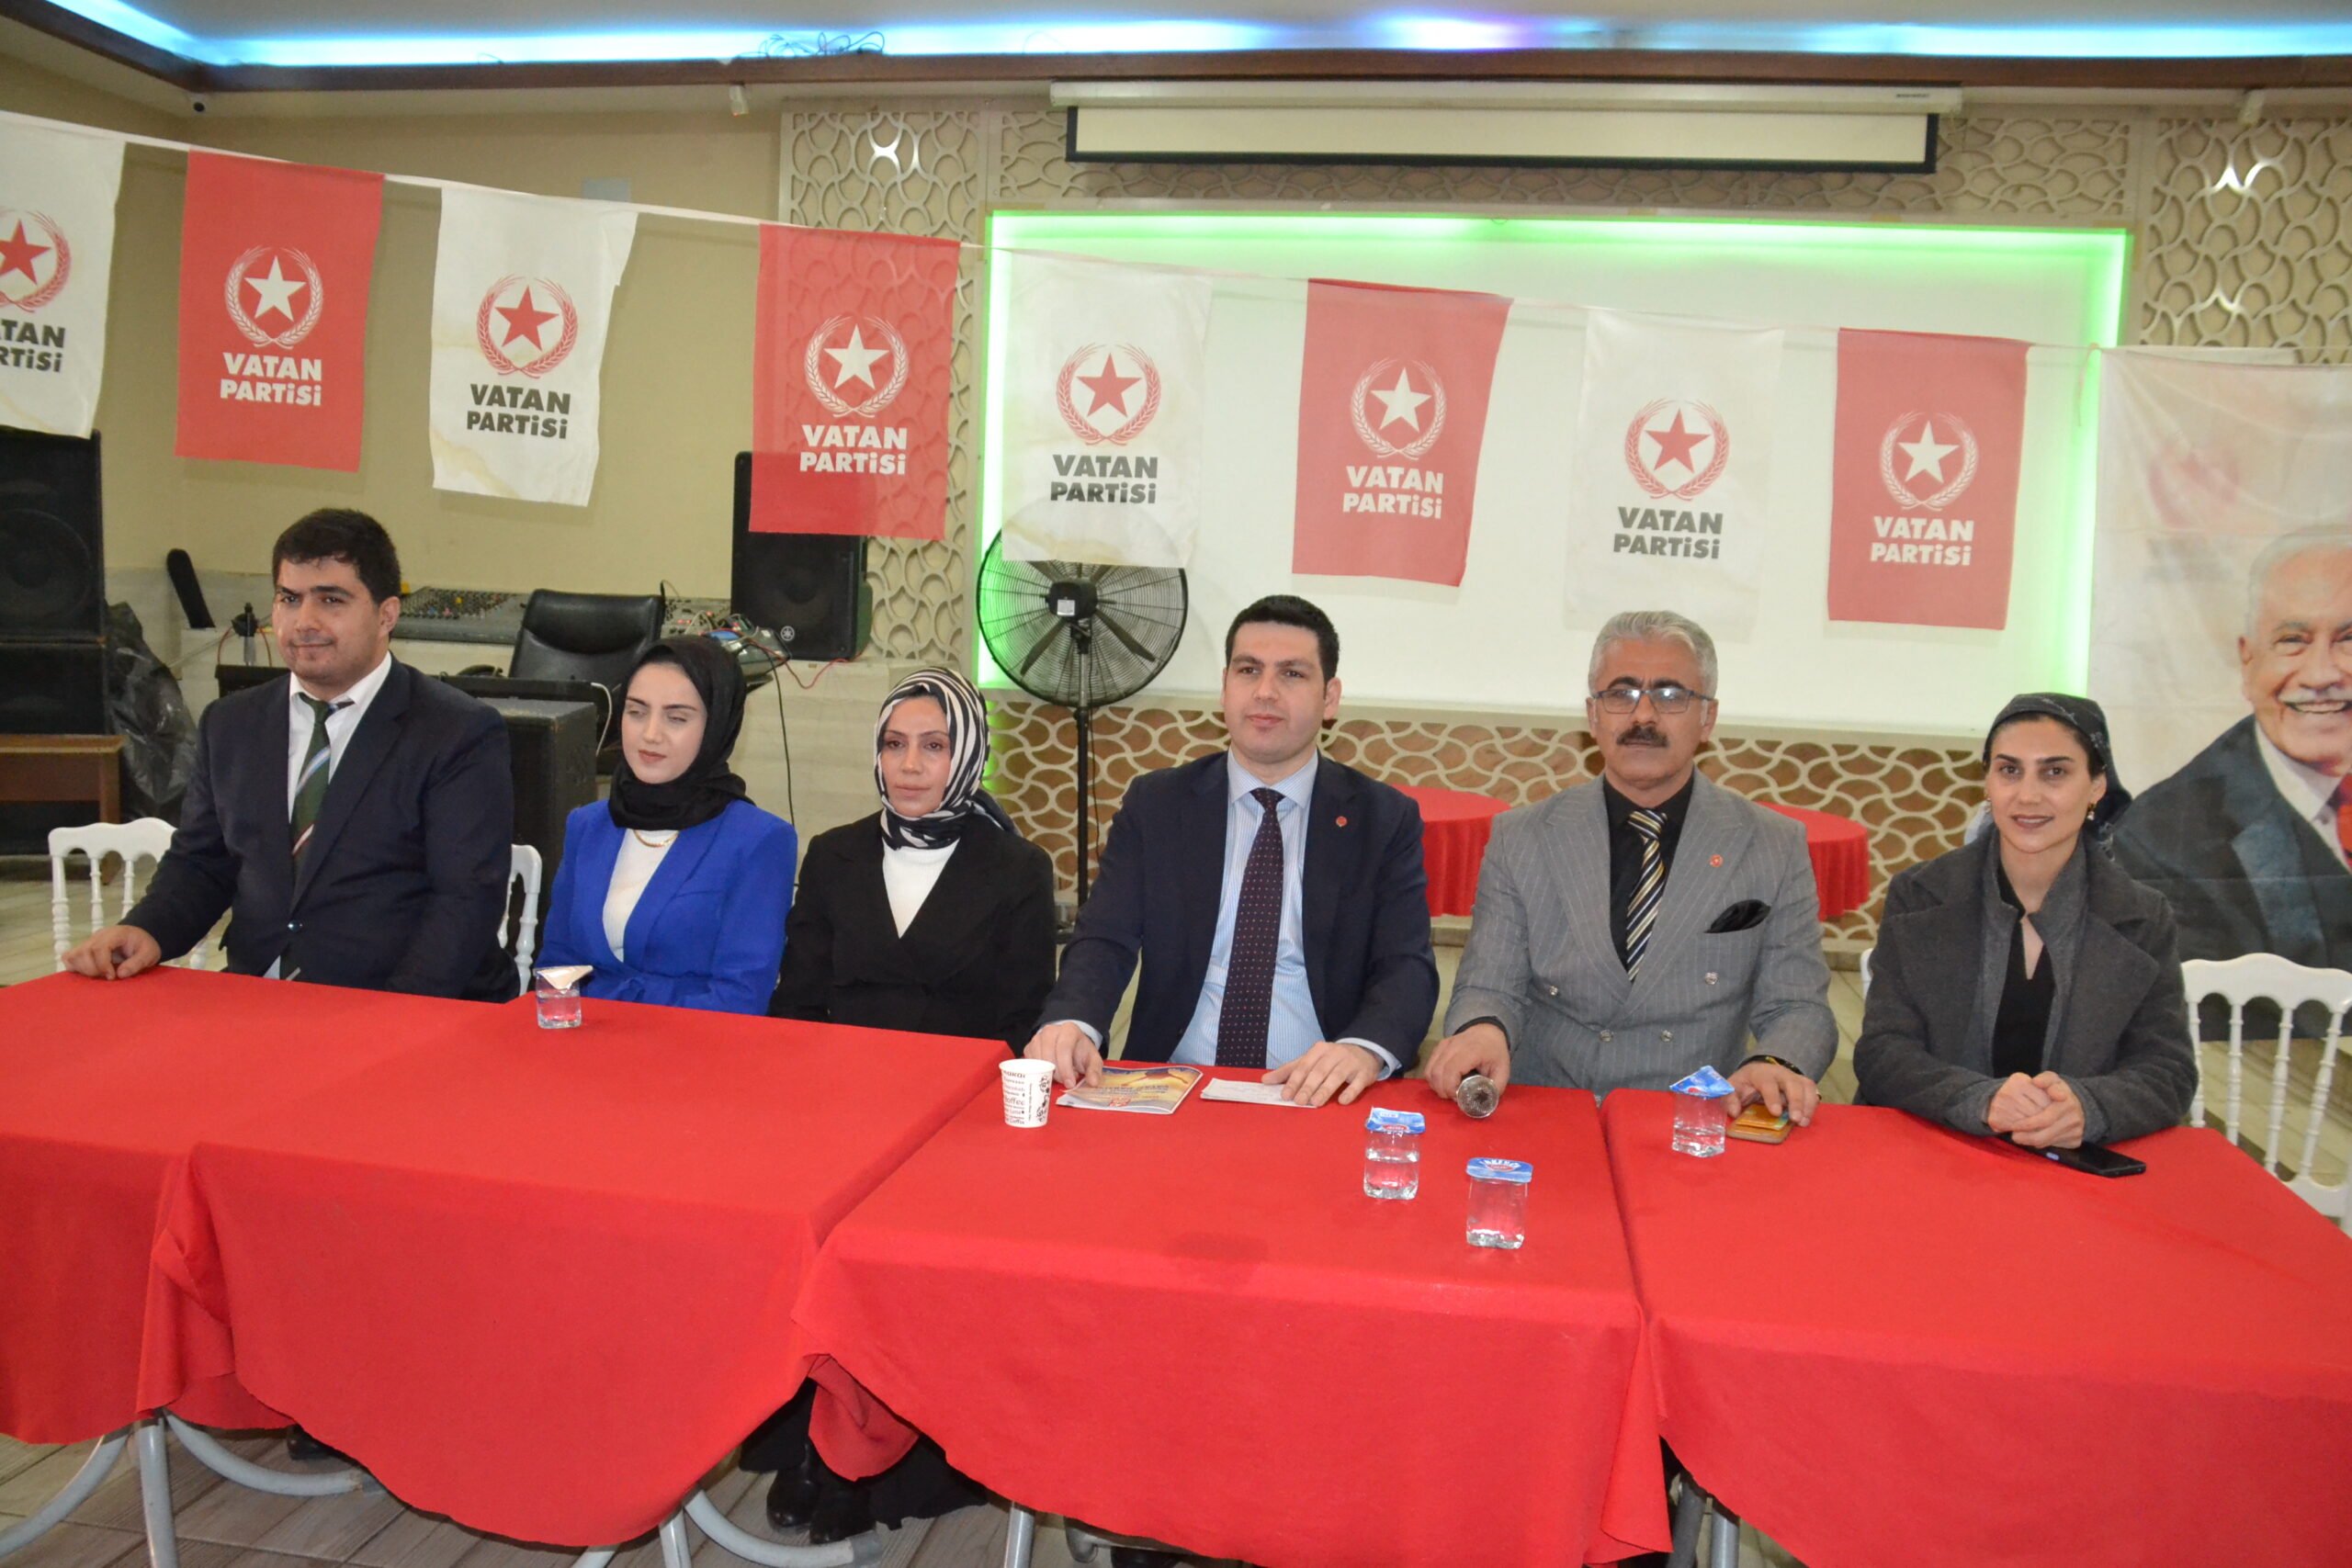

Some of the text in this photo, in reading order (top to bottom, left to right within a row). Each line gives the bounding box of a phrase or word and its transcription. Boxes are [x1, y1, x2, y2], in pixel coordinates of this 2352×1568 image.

[222, 352, 322, 382] VATAN
[469, 383, 571, 415] VATAN
[801, 423, 908, 450] VATAN
[1052, 454, 1159, 479] VATAN
[1345, 465, 1444, 495] VATAN
[1618, 505, 1724, 535] VATAN
[1873, 515, 1974, 542] VATAN
